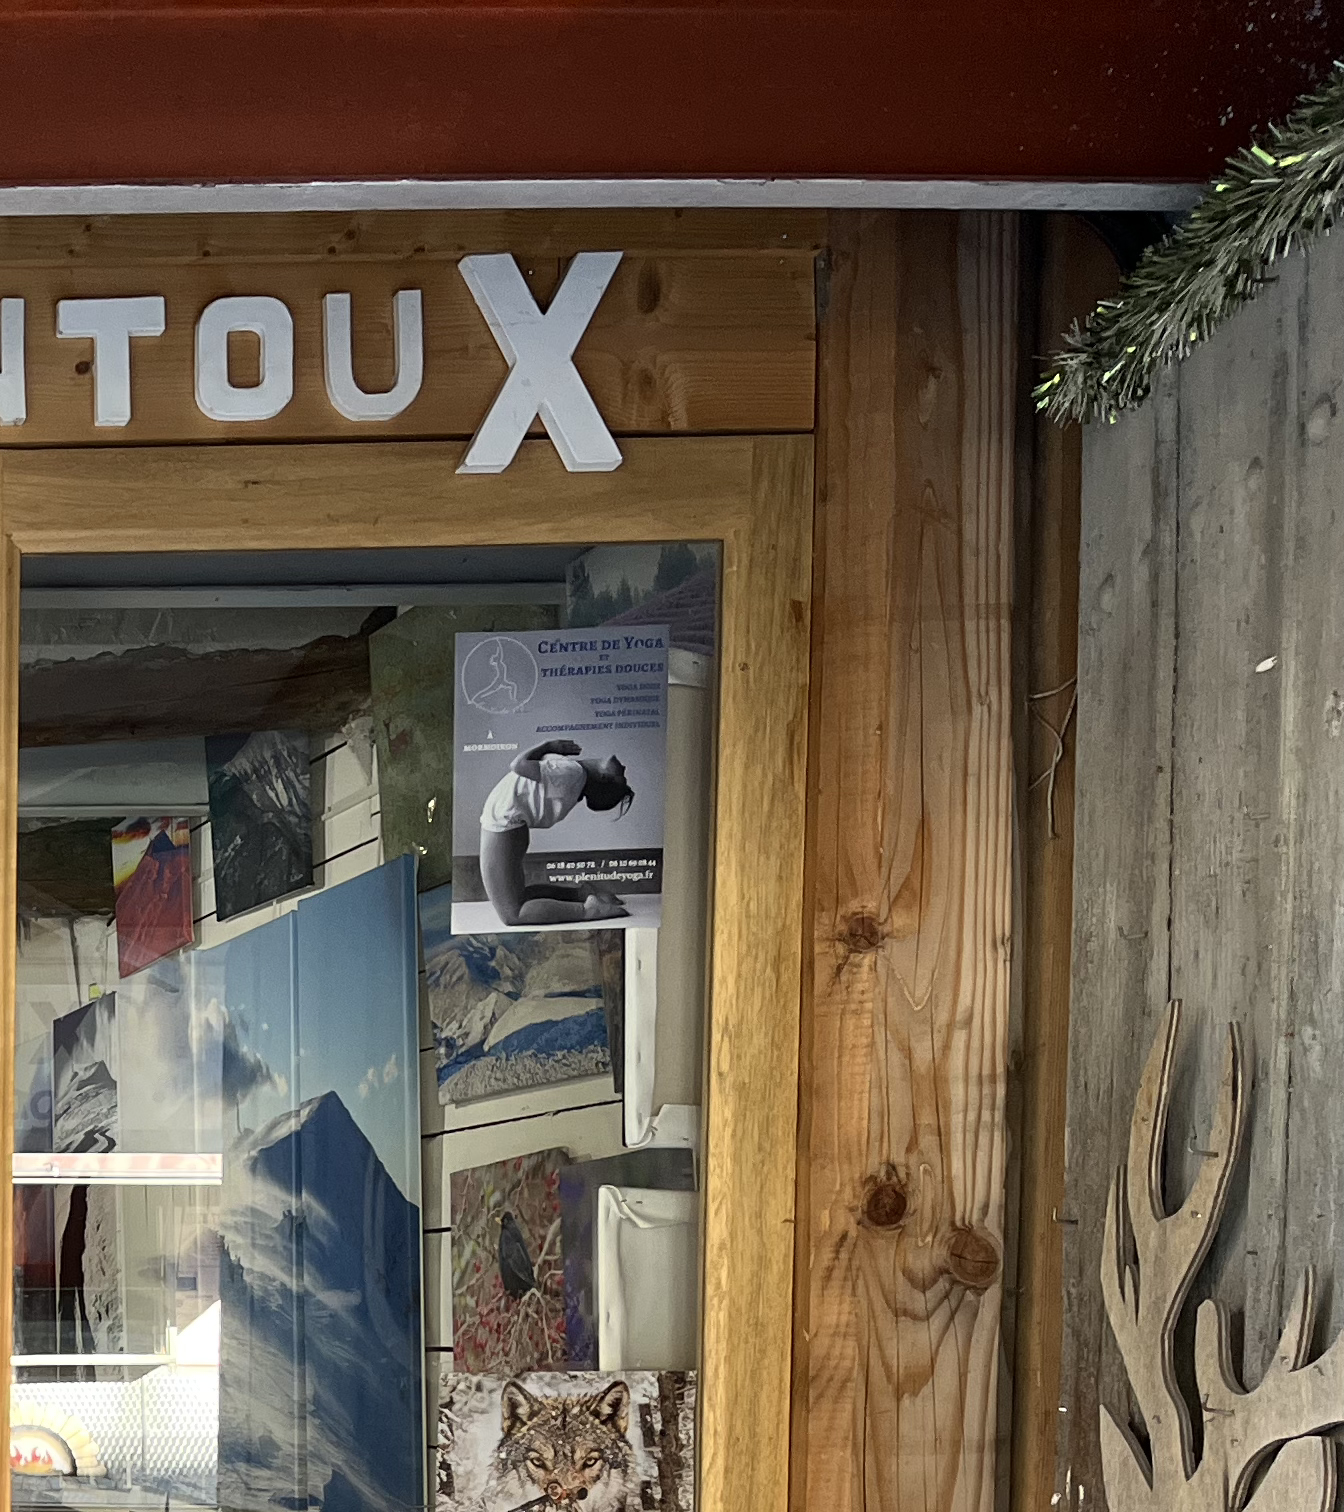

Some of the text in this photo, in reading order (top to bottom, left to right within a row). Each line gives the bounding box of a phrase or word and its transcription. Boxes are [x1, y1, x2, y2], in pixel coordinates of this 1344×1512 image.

[602, 639, 620, 650] DE
[624, 636, 664, 650] YOGA
[541, 662, 664, 678] THÉRAPIES DOUCES
[549, 869, 654, 884] www.plenitudeyoga.fr
